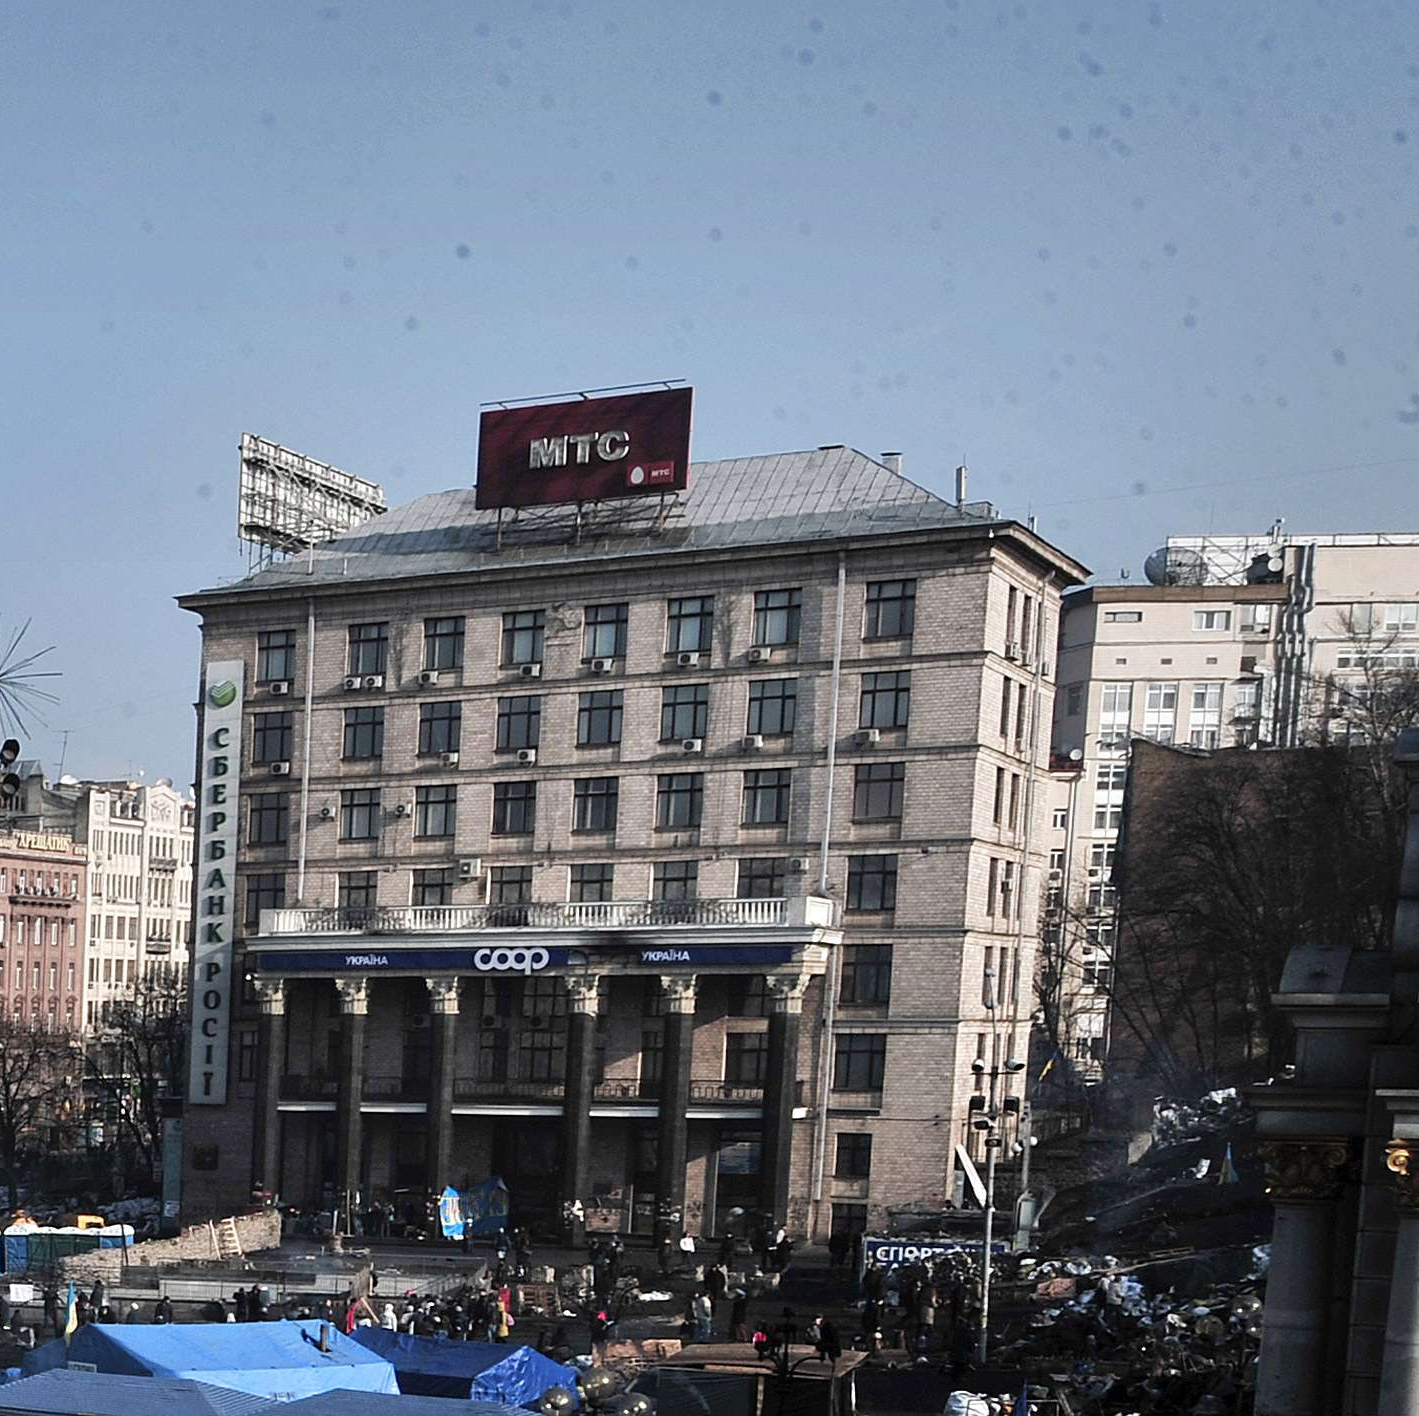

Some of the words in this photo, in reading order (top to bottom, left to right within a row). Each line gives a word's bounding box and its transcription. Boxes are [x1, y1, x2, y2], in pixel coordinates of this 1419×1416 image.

[529, 430, 630, 469] МТС
[650, 469, 671, 477] МТС
[206, 727, 230, 943] СБЕРБАНК
[345, 954, 388, 966] УКРАЇНА
[641, 950, 690, 962] УКРАЇНА
[201, 962, 221, 1096] РОСІЇ
